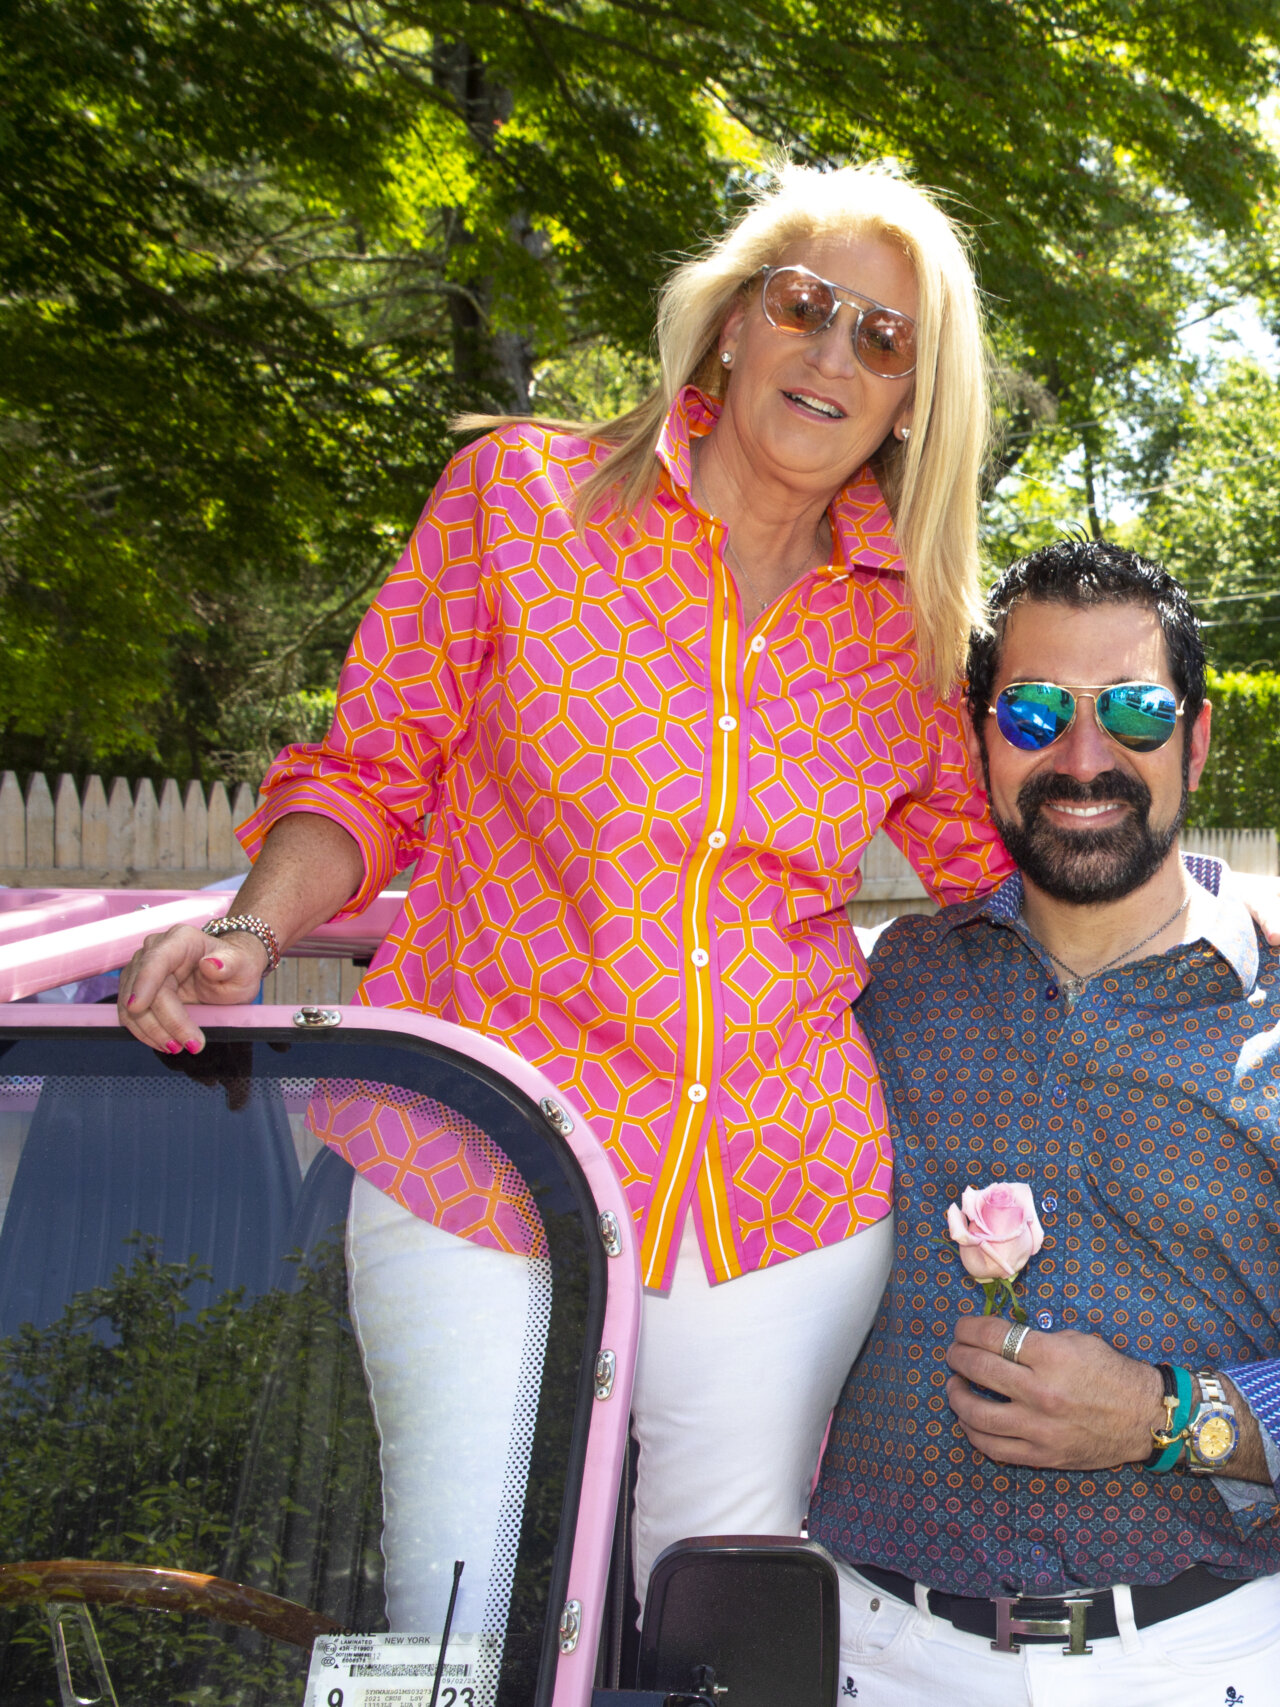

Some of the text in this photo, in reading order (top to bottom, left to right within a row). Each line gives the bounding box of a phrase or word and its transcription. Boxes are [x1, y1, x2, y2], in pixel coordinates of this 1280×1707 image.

[384, 1636, 431, 1645] NEW YORK
[441, 1687, 475, 1707] 23
